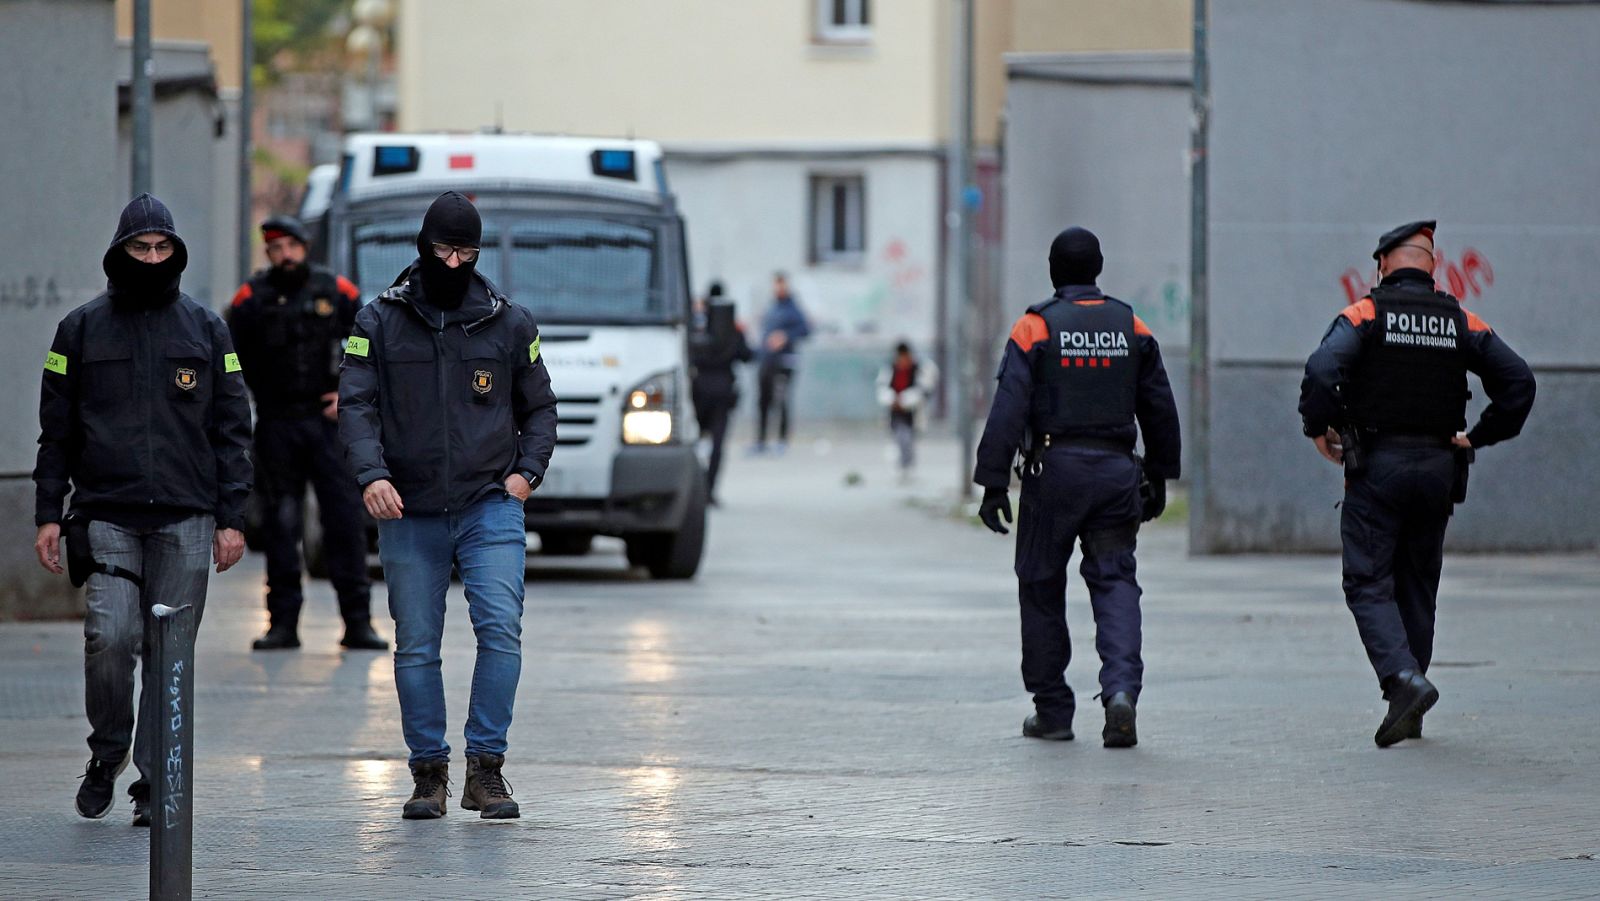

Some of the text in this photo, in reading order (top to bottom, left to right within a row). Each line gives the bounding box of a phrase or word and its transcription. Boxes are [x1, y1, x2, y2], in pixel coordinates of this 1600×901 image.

[1387, 312, 1457, 336] POLICIA
[1060, 331, 1128, 348] POLICIA
[1385, 332, 1457, 349] MOSSOS D'ESQUADRA
[1061, 348, 1128, 358] mossos d'esquadra
